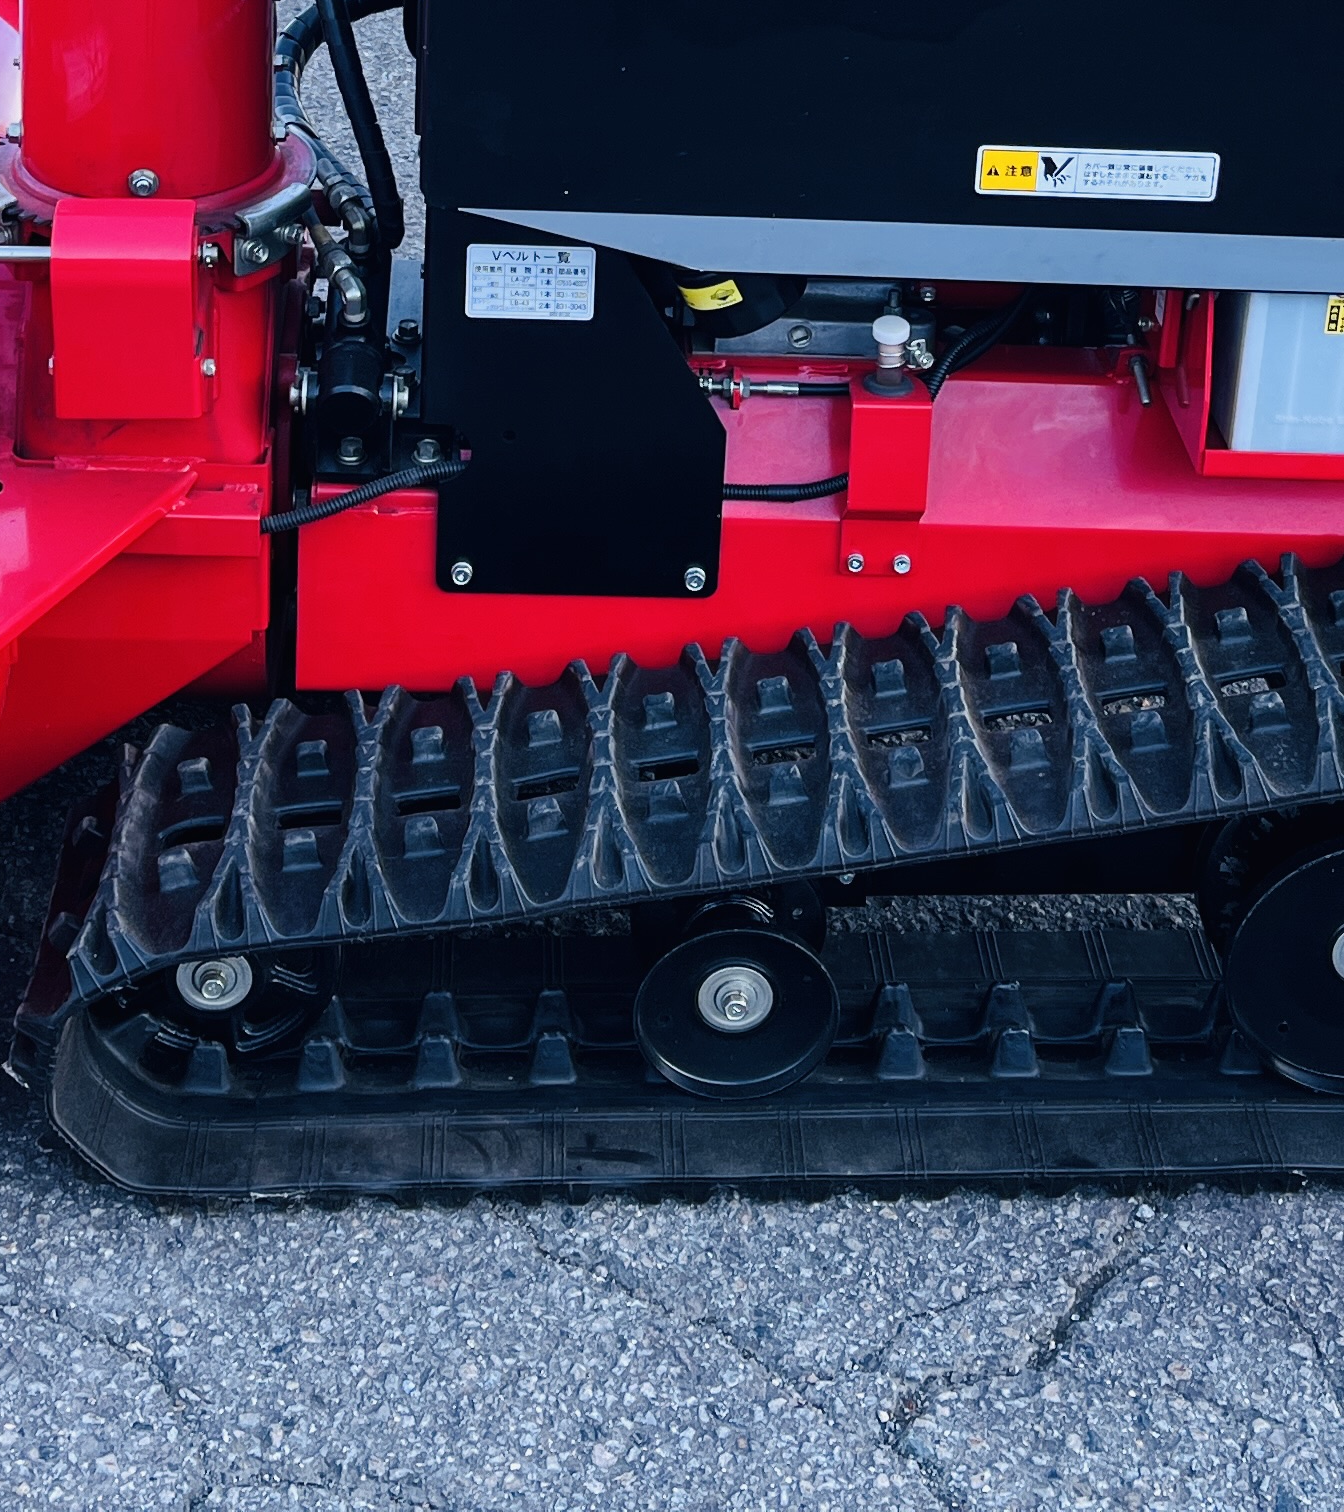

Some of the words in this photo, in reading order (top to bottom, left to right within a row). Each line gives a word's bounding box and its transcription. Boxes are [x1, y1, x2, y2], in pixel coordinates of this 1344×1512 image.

[1005, 165, 1033, 178] 注意
[492, 250, 571, 264] Vベルト一覧
